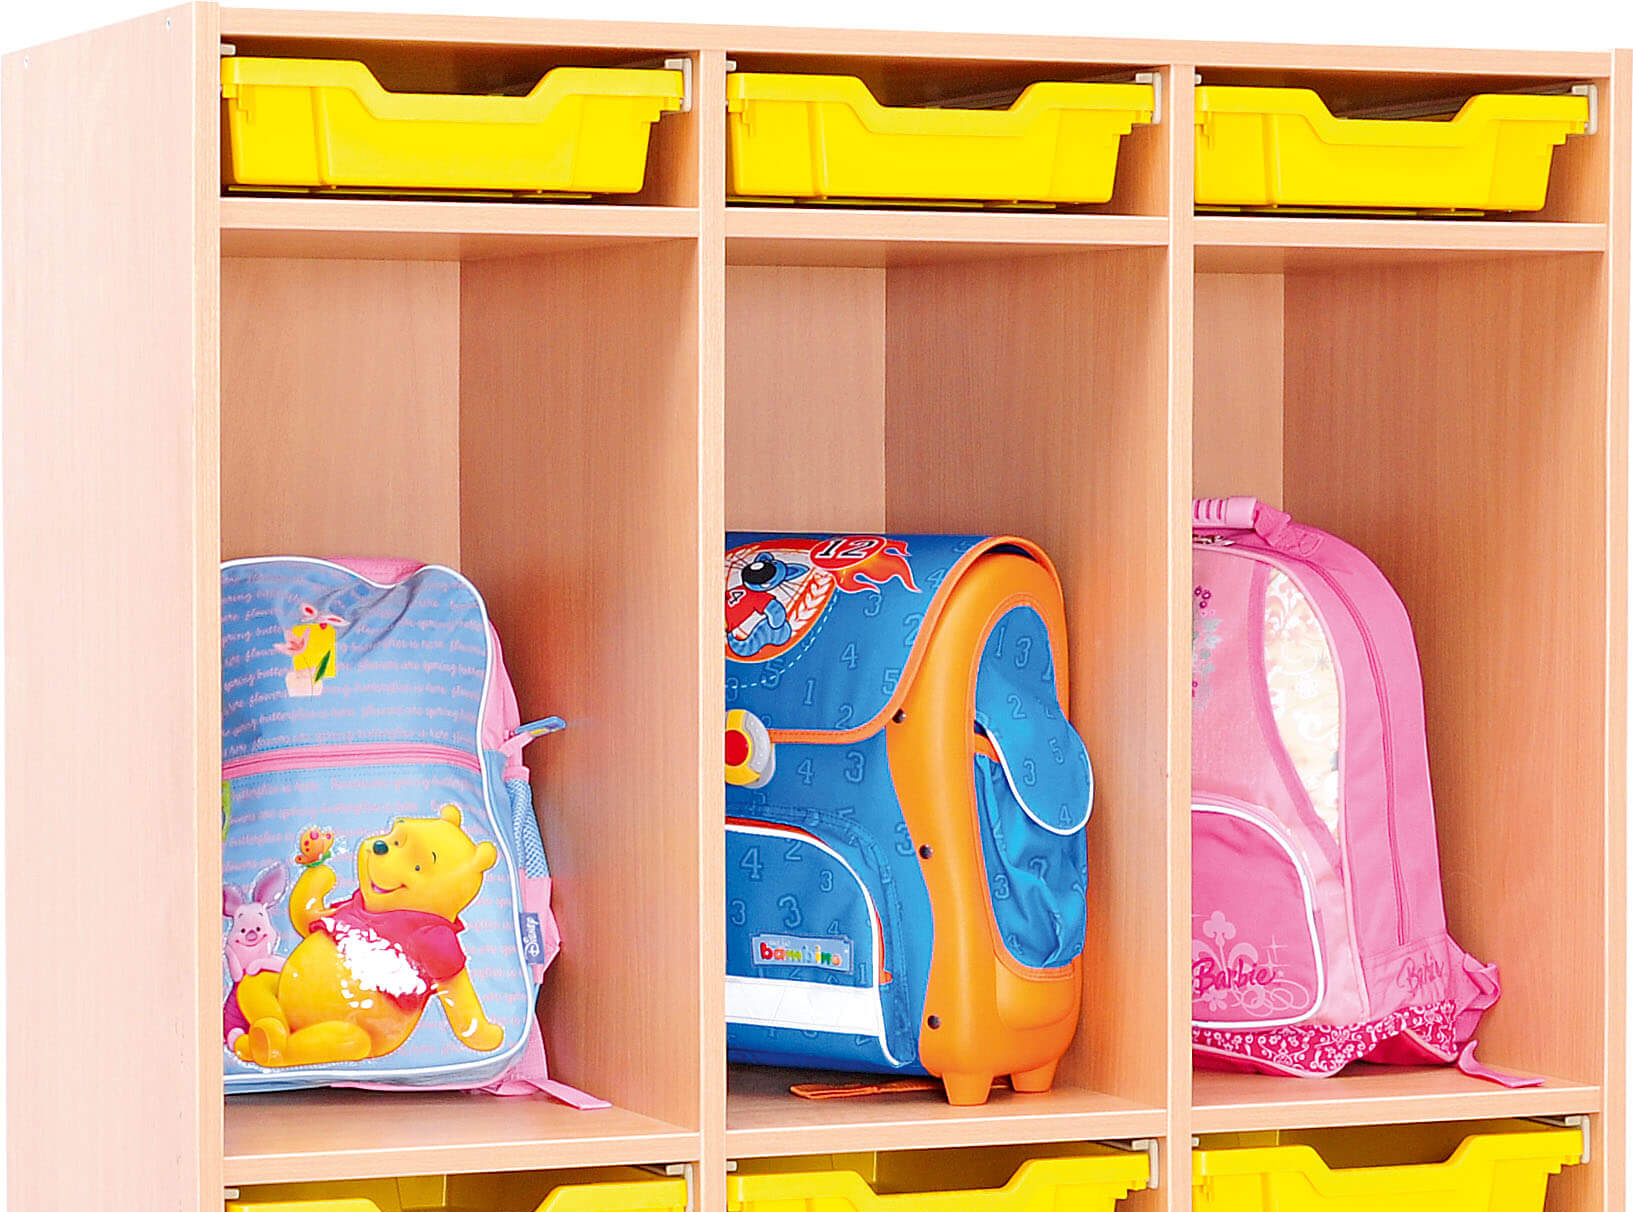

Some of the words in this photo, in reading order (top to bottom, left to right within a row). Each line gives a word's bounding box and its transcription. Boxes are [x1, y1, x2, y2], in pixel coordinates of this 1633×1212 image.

[815, 539, 879, 559] 12
[729, 590, 746, 607] 4
[864, 594, 882, 616] 3
[904, 613, 923, 646] 2
[841, 643, 858, 669] 4
[1015, 637, 1032, 668] 3
[804, 680, 817, 705] 1
[883, 668, 899, 694] 5
[835, 704, 854, 729] 2
[1008, 695, 1028, 719] 2
[797, 759, 815, 785] 4
[844, 751, 866, 784] 3
[1023, 759, 1037, 786] 3
[1058, 804, 1074, 826] 4
[785, 838, 803, 862] 2
[895, 822, 914, 856] 3
[740, 847, 763, 880] 4
[820, 869, 834, 893] 3
[994, 874, 1010, 899] 3
[730, 900, 746, 926] 3
[778, 895, 802, 928] 3
[760, 941, 843, 966] bambino
[857, 962, 868, 986] 1
[1192, 957, 1276, 997] Barbie
